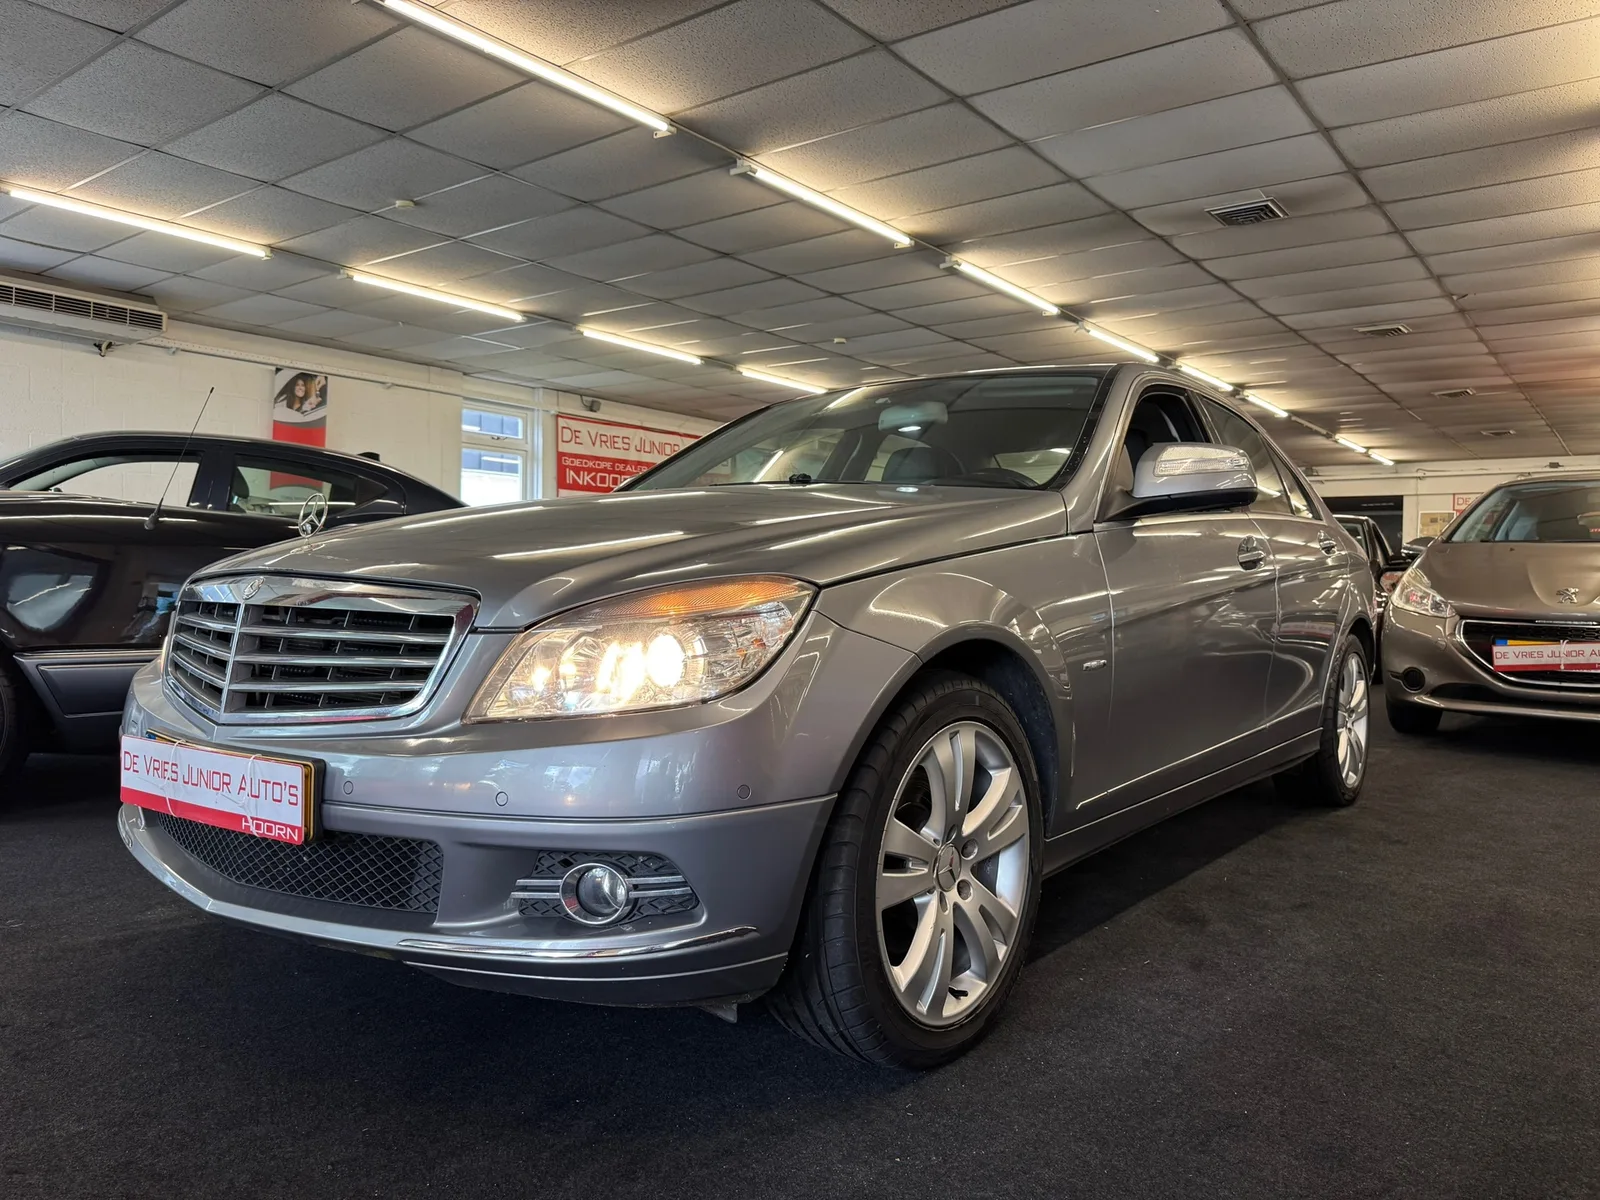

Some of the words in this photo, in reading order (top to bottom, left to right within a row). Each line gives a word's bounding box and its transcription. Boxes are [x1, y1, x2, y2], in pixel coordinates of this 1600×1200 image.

[561, 426, 583, 445] DE
[587, 430, 631, 451] VRIES
[562, 456, 613, 470] GOEDKOPE
[1456, 497, 1471, 505] DE
[1495, 651, 1509, 659] DE
[1513, 650, 1544, 659] VRIES
[123, 751, 139, 774] DE
[143, 755, 179, 782] VRIES
[182, 763, 232, 794] JUNIOR
[237, 774, 298, 806] AUTO'S
[241, 817, 299, 842] HOORN
